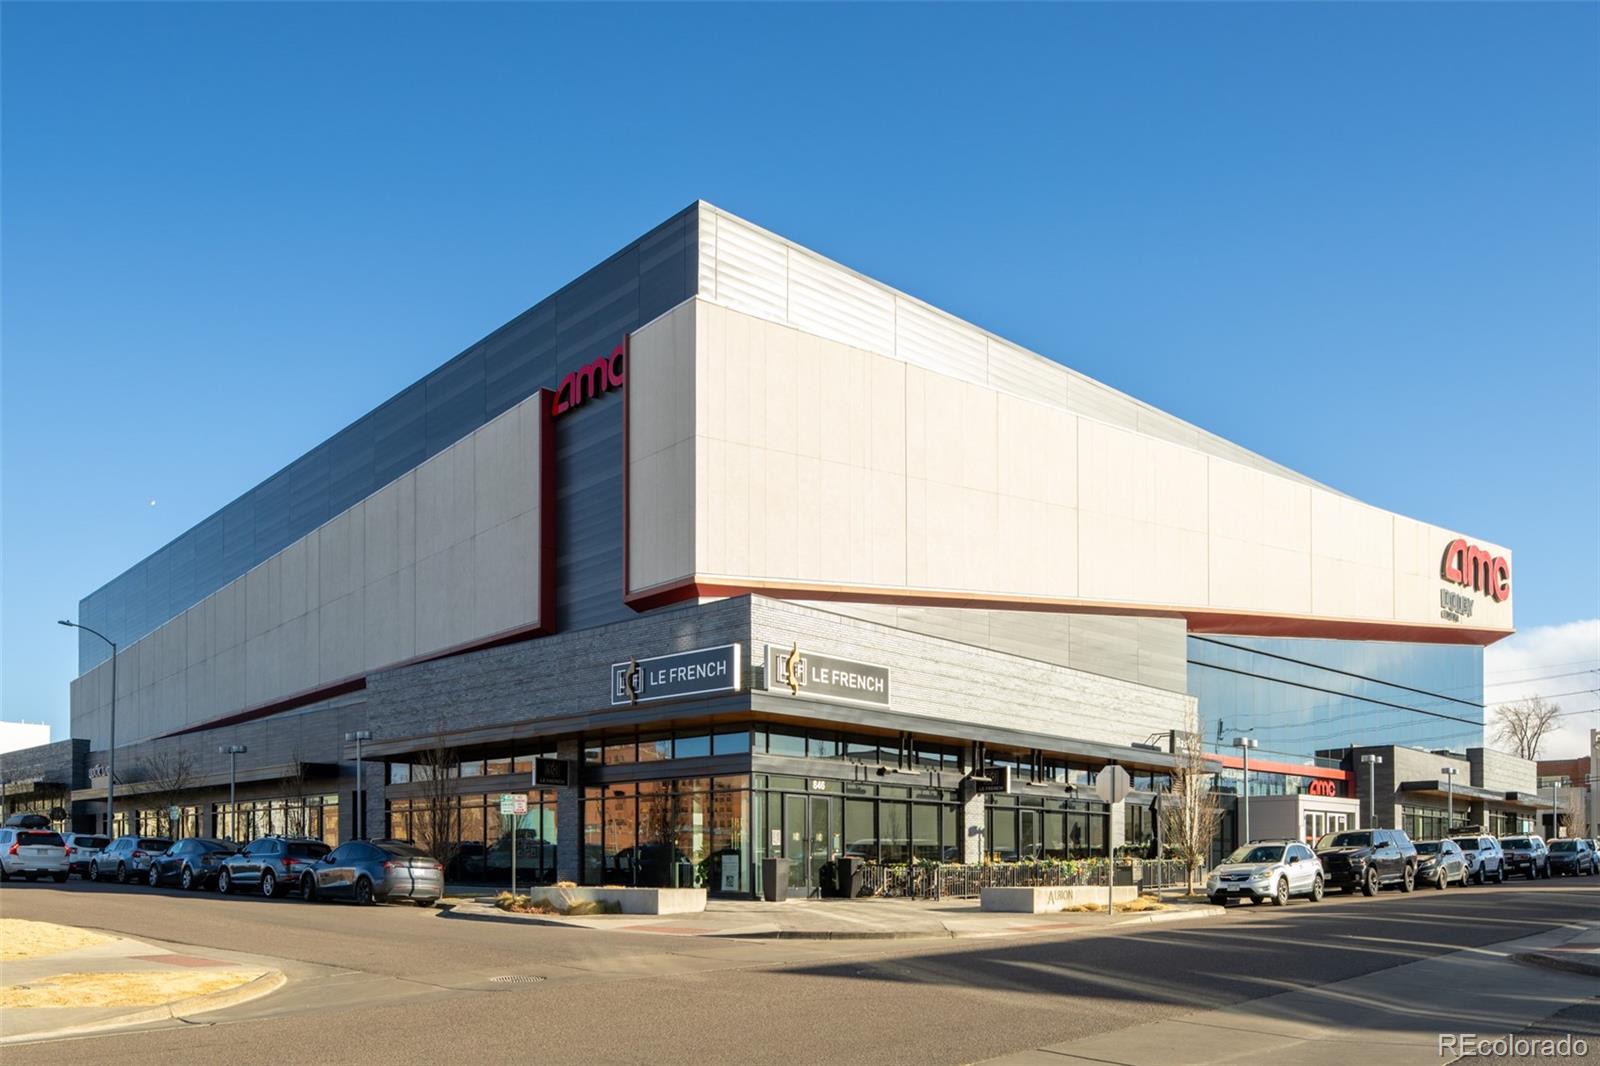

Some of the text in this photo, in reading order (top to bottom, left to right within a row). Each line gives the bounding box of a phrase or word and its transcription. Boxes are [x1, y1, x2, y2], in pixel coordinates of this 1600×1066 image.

[1441, 538, 1510, 603] amc
[650, 669, 667, 686] LE
[669, 659, 727, 683] FRENCH
[812, 667, 830, 684] LE
[832, 670, 884, 693] FRENCH
[1309, 779, 1336, 797] amc
